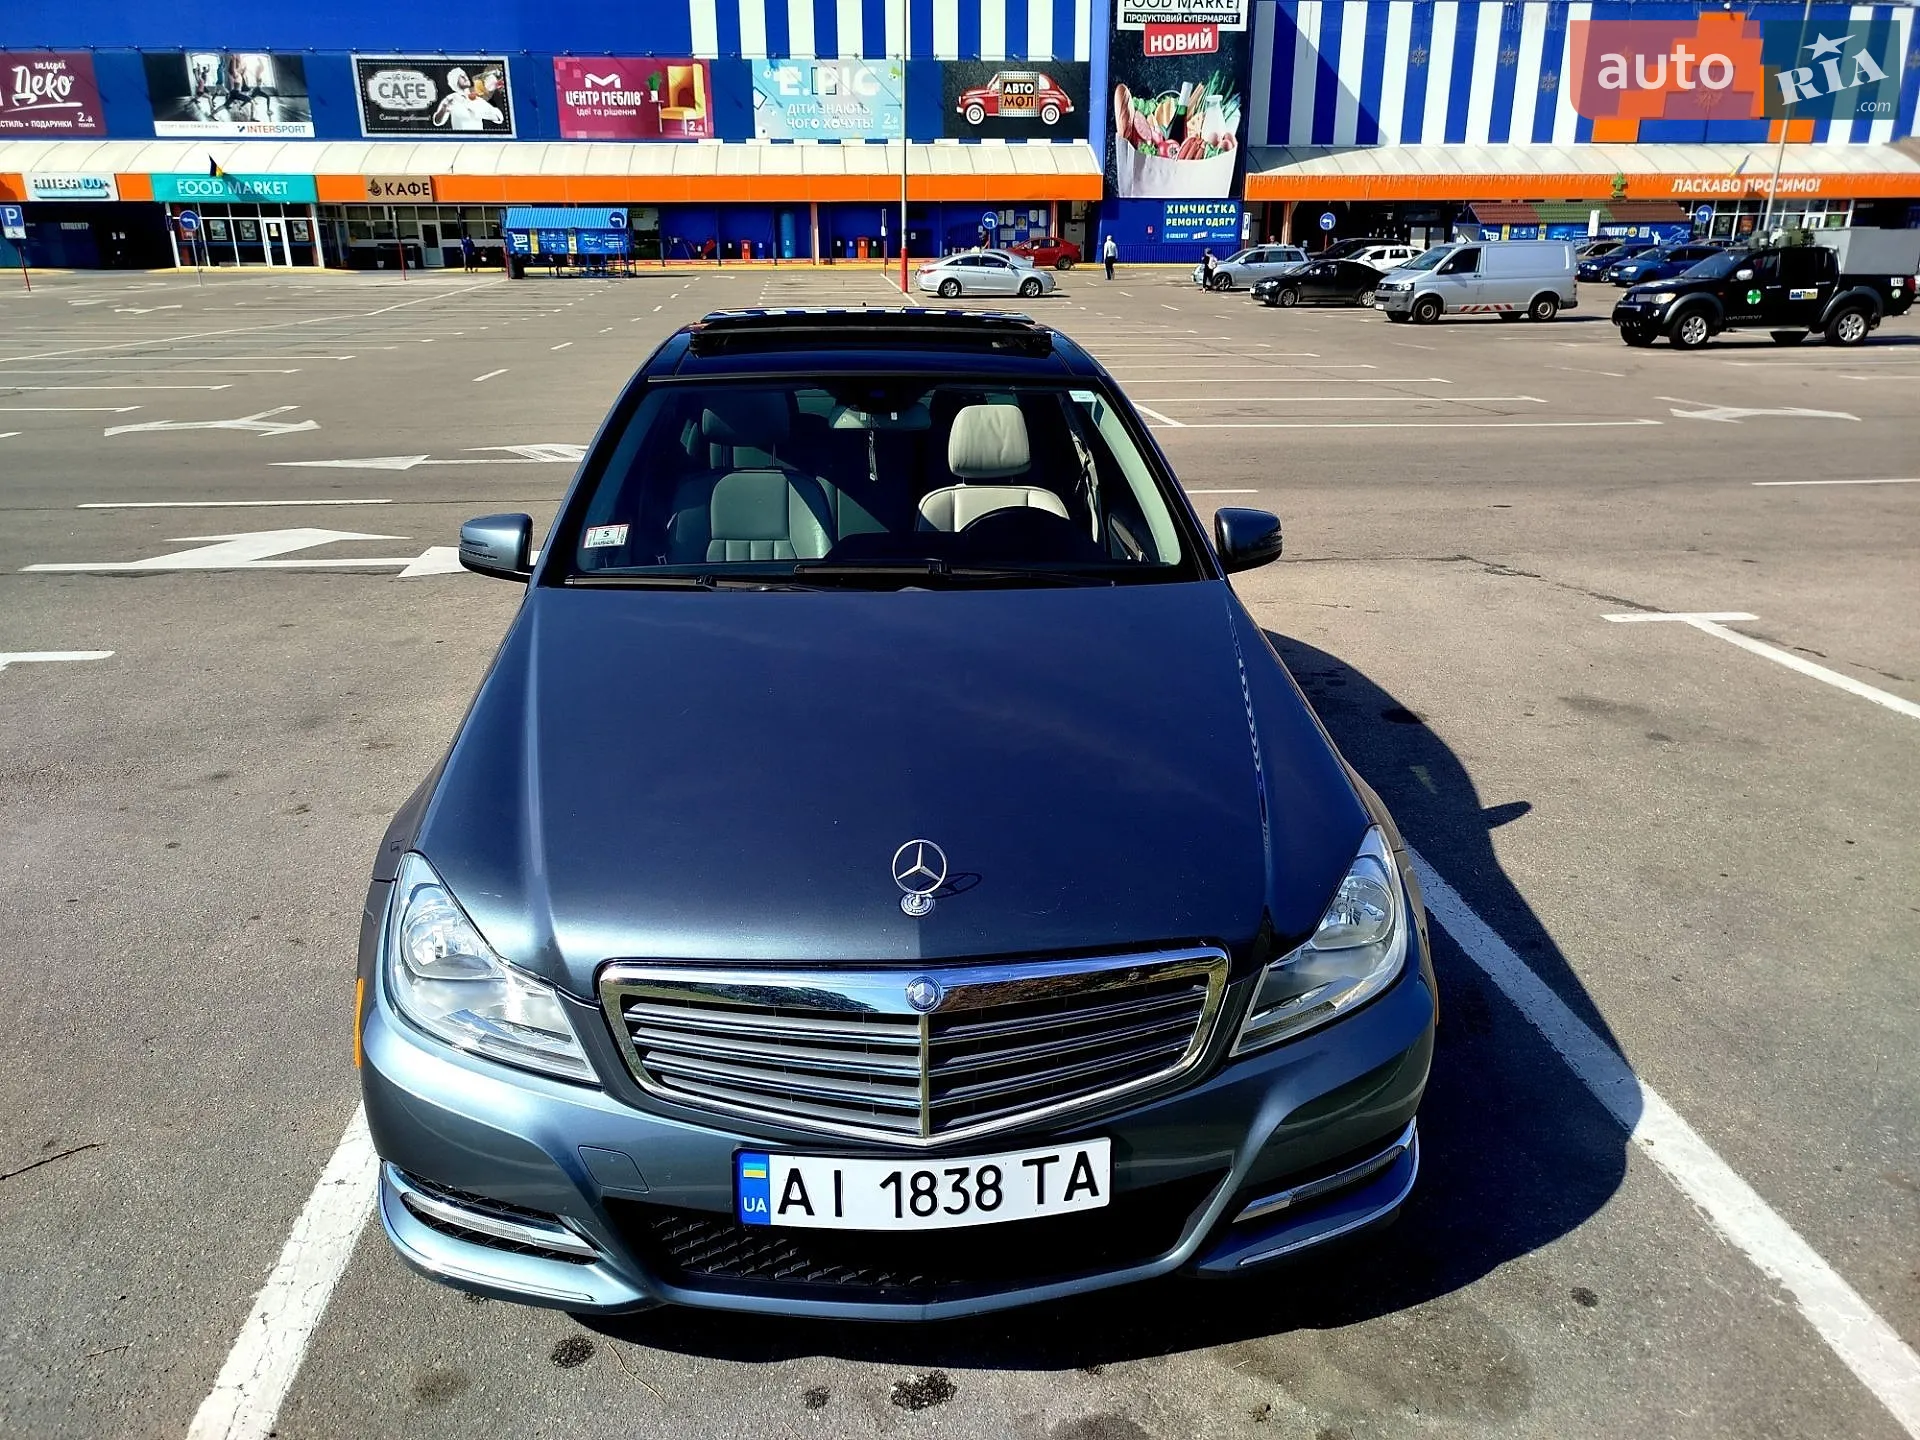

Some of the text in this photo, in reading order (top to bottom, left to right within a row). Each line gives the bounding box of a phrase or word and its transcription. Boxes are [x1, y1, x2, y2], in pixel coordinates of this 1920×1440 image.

[1126, 13, 1238, 23] ПРОДУКТОВИЙ СУПЕРМАРКЕТ
[1150, 28, 1213, 53] НОВИЙ
[378, 83, 427, 99] CAFE
[1005, 83, 1034, 94] АВТО
[566, 90, 599, 106] ЦЕНТР
[1004, 97, 1034, 107] МОЛ
[787, 103, 816, 116] ДІТИ
[0, 120, 72, 129] СТИЛЬ ПОДАРУНКИ
[247, 125, 306, 134] INTERSPORT
[786, 117, 819, 129] ЧОГО
[33, 179, 80, 189] АПТЕКА
[177, 181, 288, 194] FOOD MARKET
[385, 182, 430, 196] КАФЕ
[1671, 178, 1822, 193] ЛАСКАВО ПРОСИМО!
[1166, 204, 1236, 214] ХІМЧИСТКА
[5, 208, 17, 225] P
[1166, 218, 1236, 228] РЕМОНТ ОДЯГУ
[777, 1150, 1100, 1219] AI 1838 TA
[744, 1197, 767, 1213] UA
